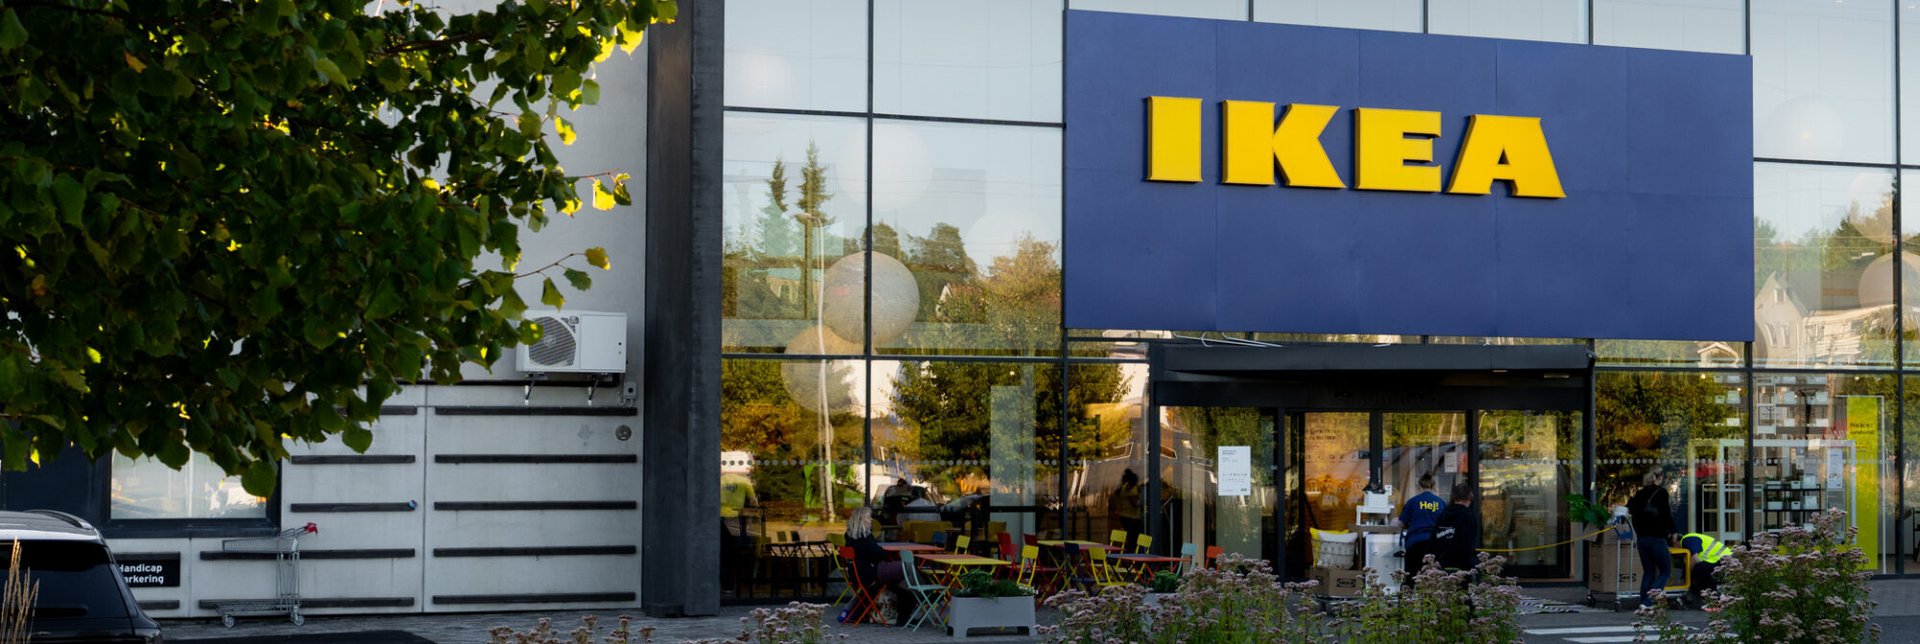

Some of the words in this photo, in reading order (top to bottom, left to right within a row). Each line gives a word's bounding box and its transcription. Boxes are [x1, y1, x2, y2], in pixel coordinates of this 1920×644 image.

[1145, 95, 1567, 199] IKEA
[1419, 500, 1439, 512] Hej!
[123, 574, 164, 585] arkering
